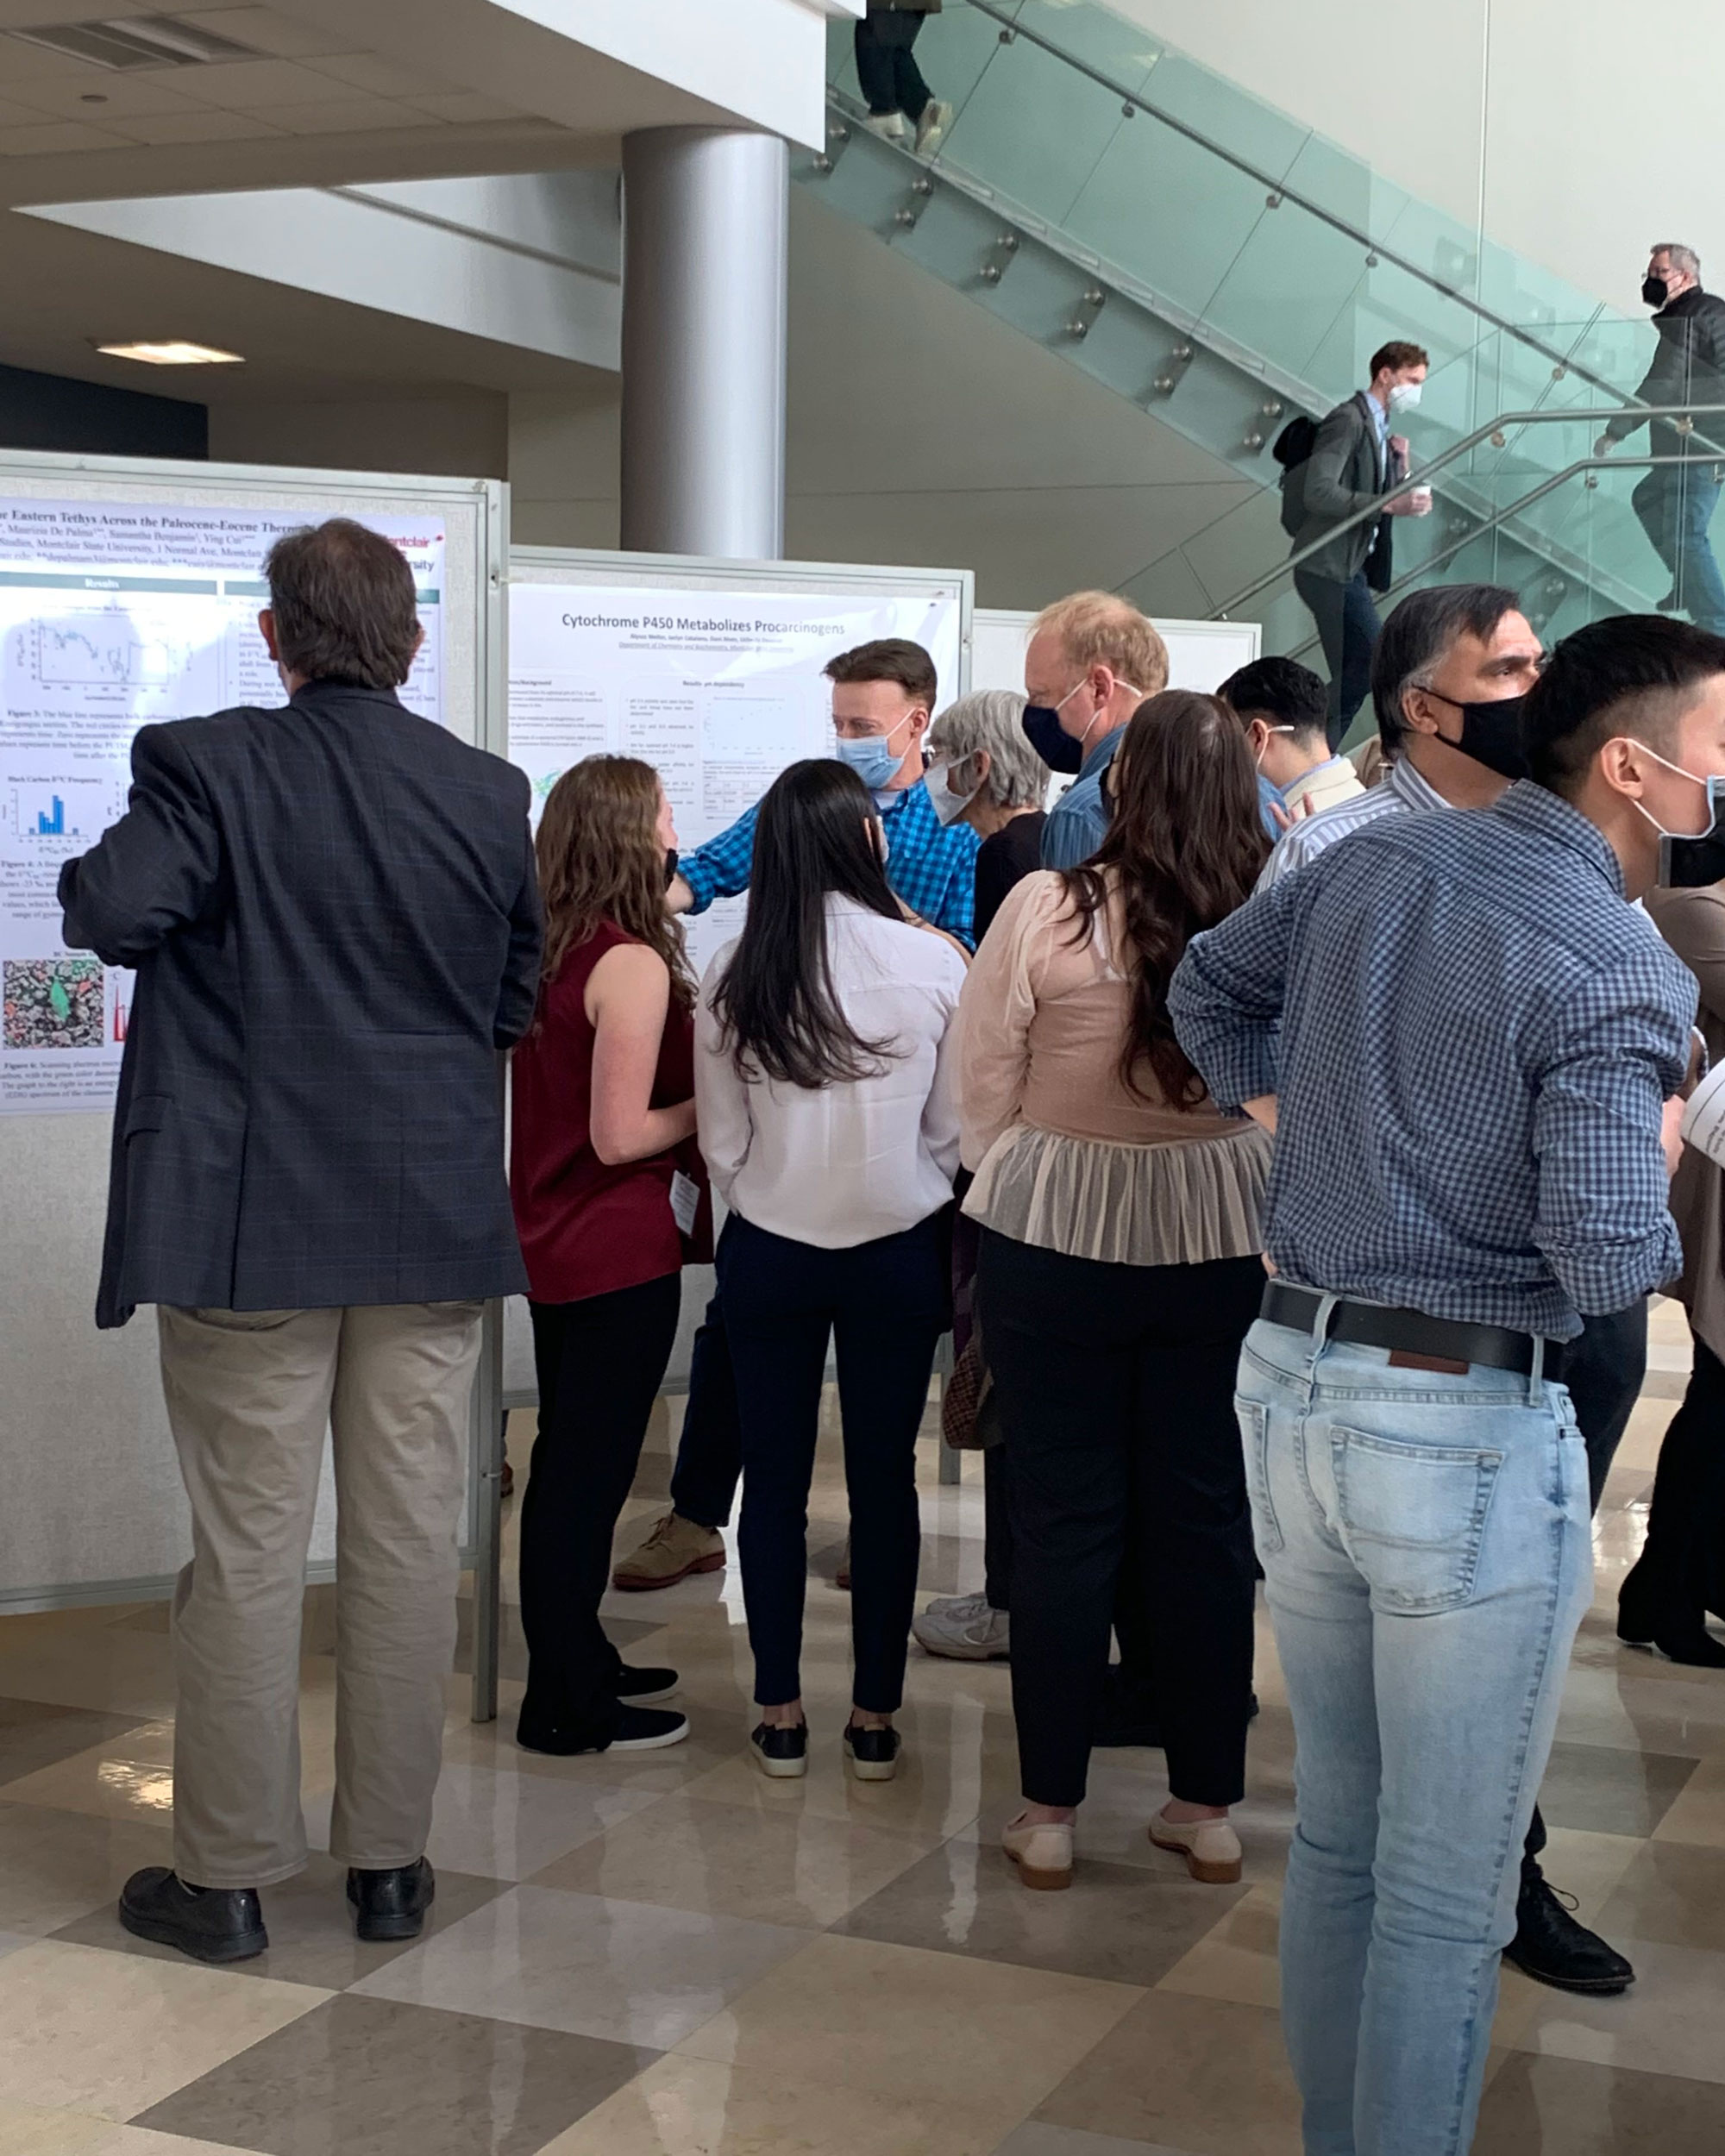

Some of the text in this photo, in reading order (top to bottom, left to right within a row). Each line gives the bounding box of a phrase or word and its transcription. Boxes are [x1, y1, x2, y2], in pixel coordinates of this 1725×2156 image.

[12, 510, 57, 523] Eastern
[60, 511, 97, 527] Tethys
[100, 515, 138, 526] Across
[140, 517, 159, 528] the
[161, 517, 259, 532] Paleocene-Eocene
[561, 613, 845, 637] Cytochrome P450 Metabolizes Procarcinogens
